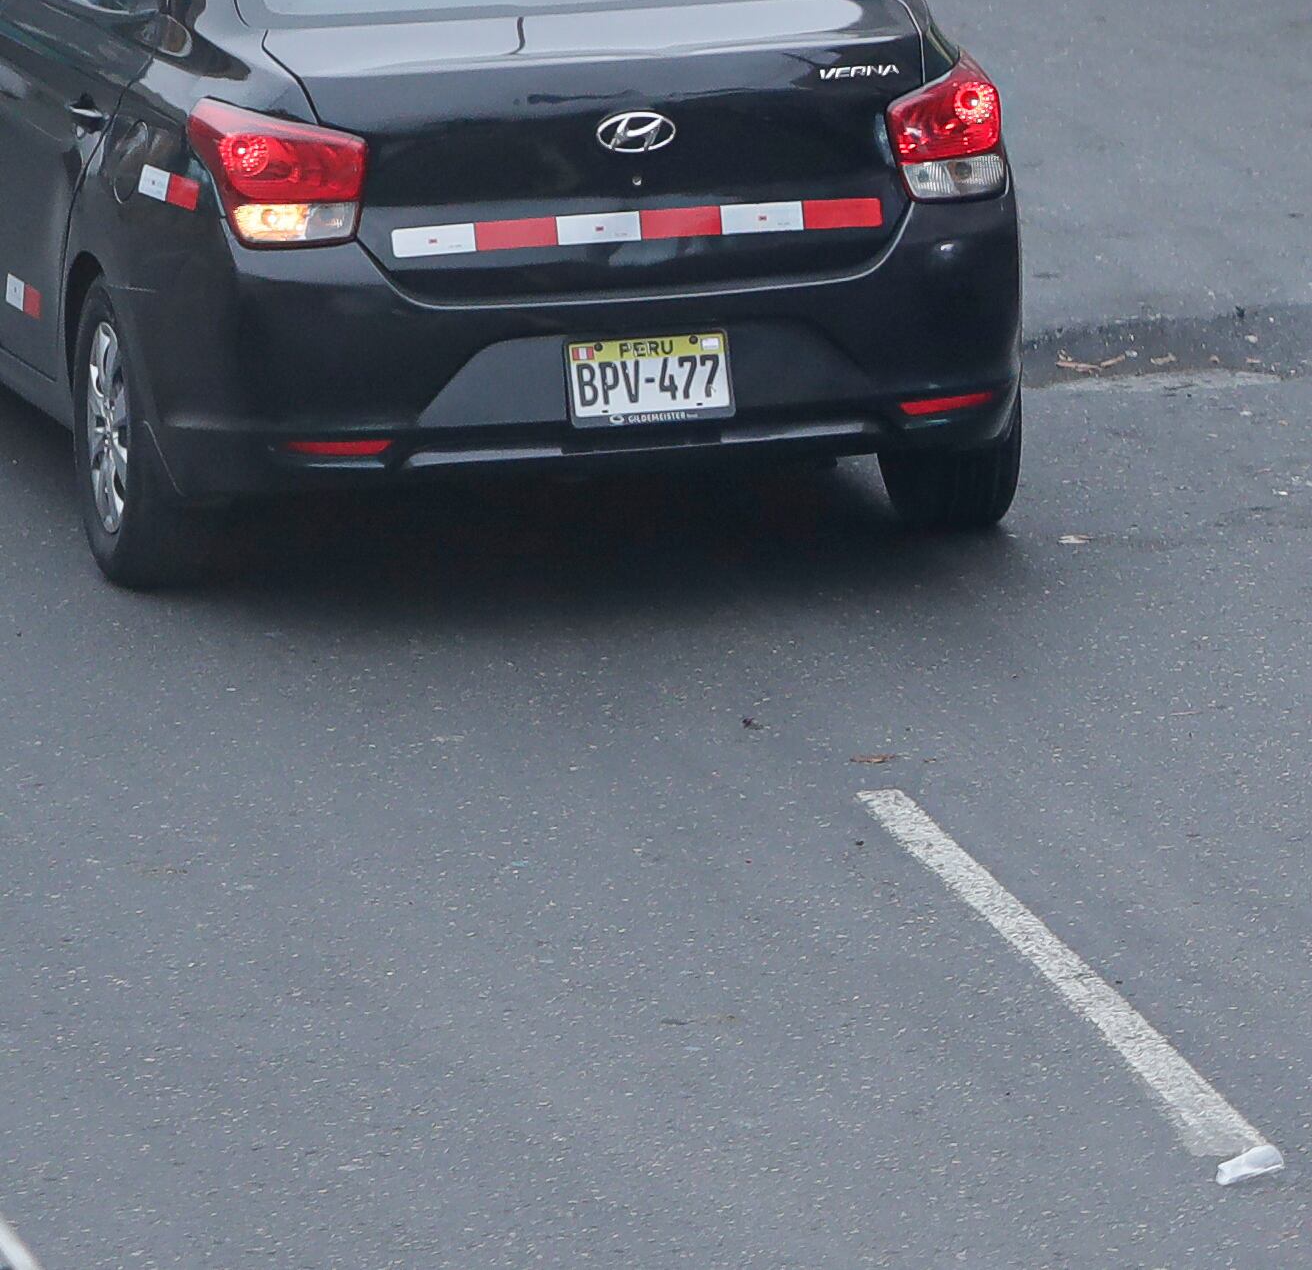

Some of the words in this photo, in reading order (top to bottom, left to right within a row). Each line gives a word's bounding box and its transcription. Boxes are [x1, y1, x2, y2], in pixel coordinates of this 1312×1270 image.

[819, 63, 900, 80] VERNA
[618, 339, 674, 358] PERU
[575, 353, 720, 408] BPV-477
[627, 411, 687, 424] GILDEMEISTER
